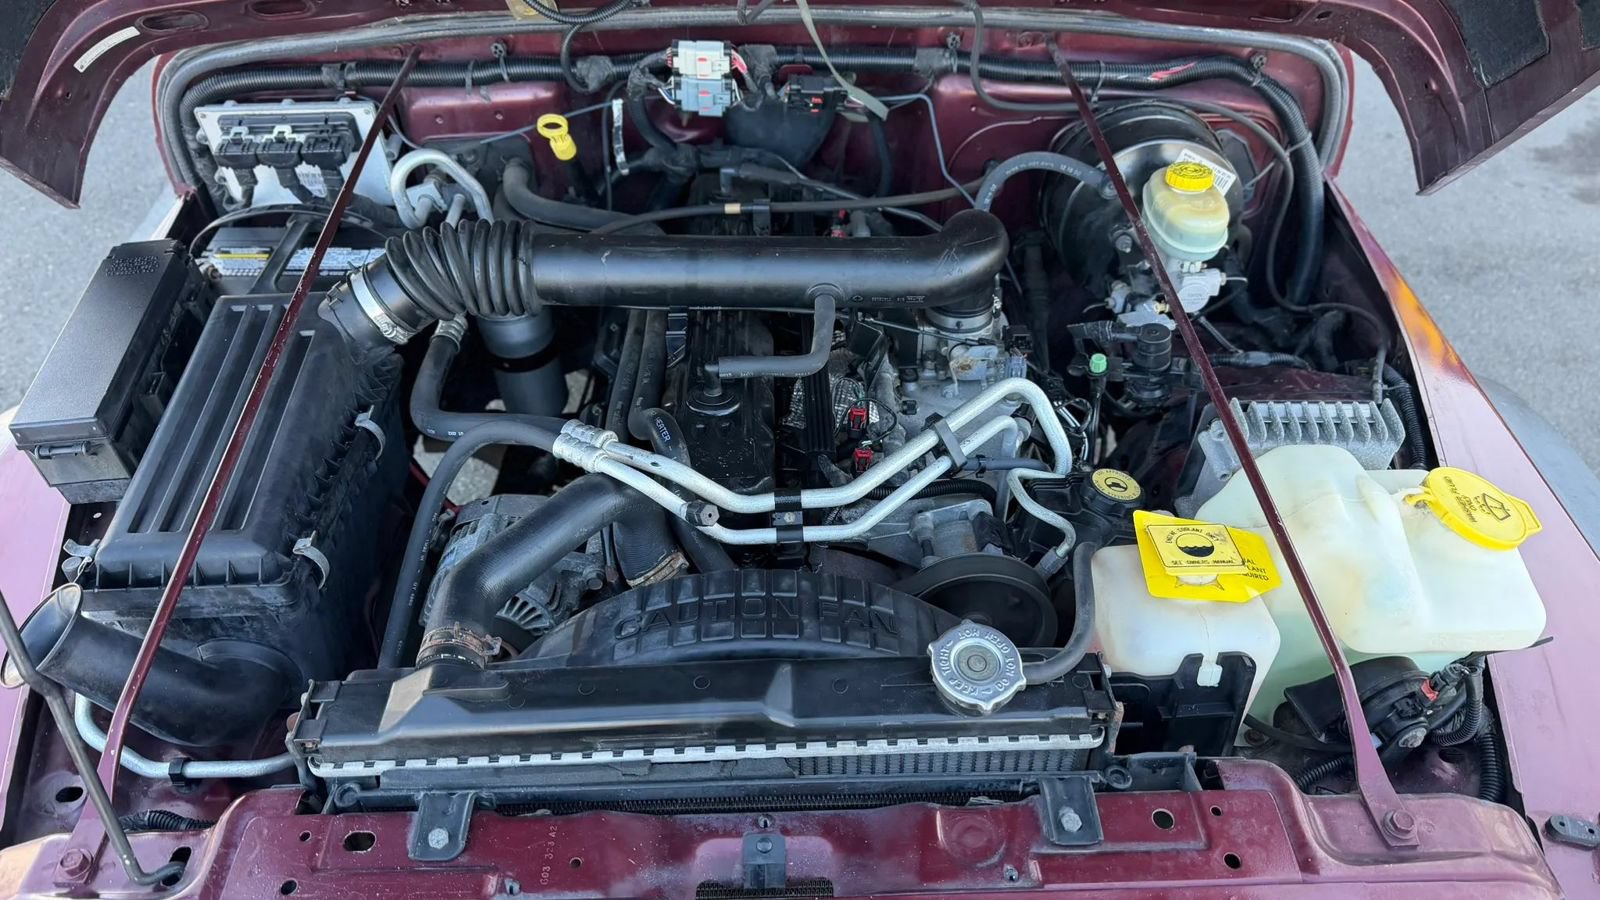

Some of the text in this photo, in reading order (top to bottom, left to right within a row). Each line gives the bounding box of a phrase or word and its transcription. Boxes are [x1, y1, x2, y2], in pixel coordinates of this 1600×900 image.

[1246, 564, 1267, 574] LANT
[614, 598, 898, 640] CAUTION FAN
[939, 648, 979, 696] KEEP TIGHT
[958, 627, 1016, 692] DO NOT OPEN HOT
